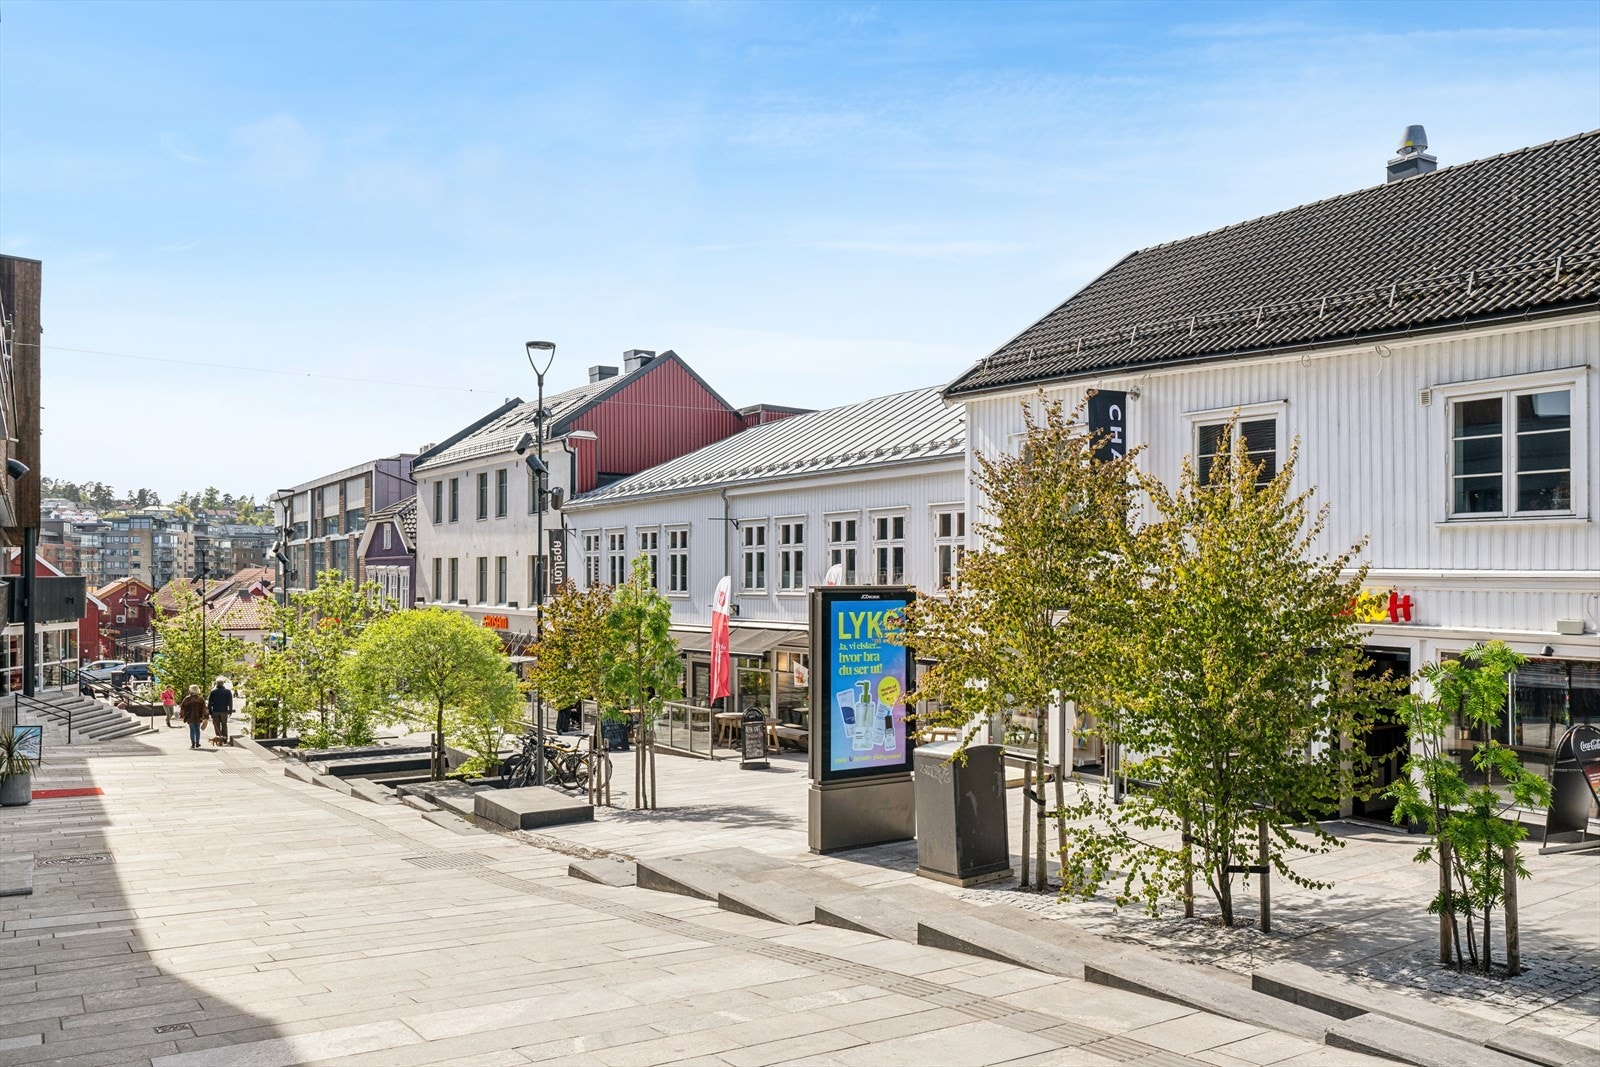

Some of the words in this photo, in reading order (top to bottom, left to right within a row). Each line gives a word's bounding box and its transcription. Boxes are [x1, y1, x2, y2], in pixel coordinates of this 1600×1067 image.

[849, 642, 856, 650] vi
[839, 653, 862, 663] hvor
[864, 652, 880, 662] bra
[839, 665, 852, 675] du
[854, 666, 869, 675] ser
[870, 664, 883, 674] ut!
